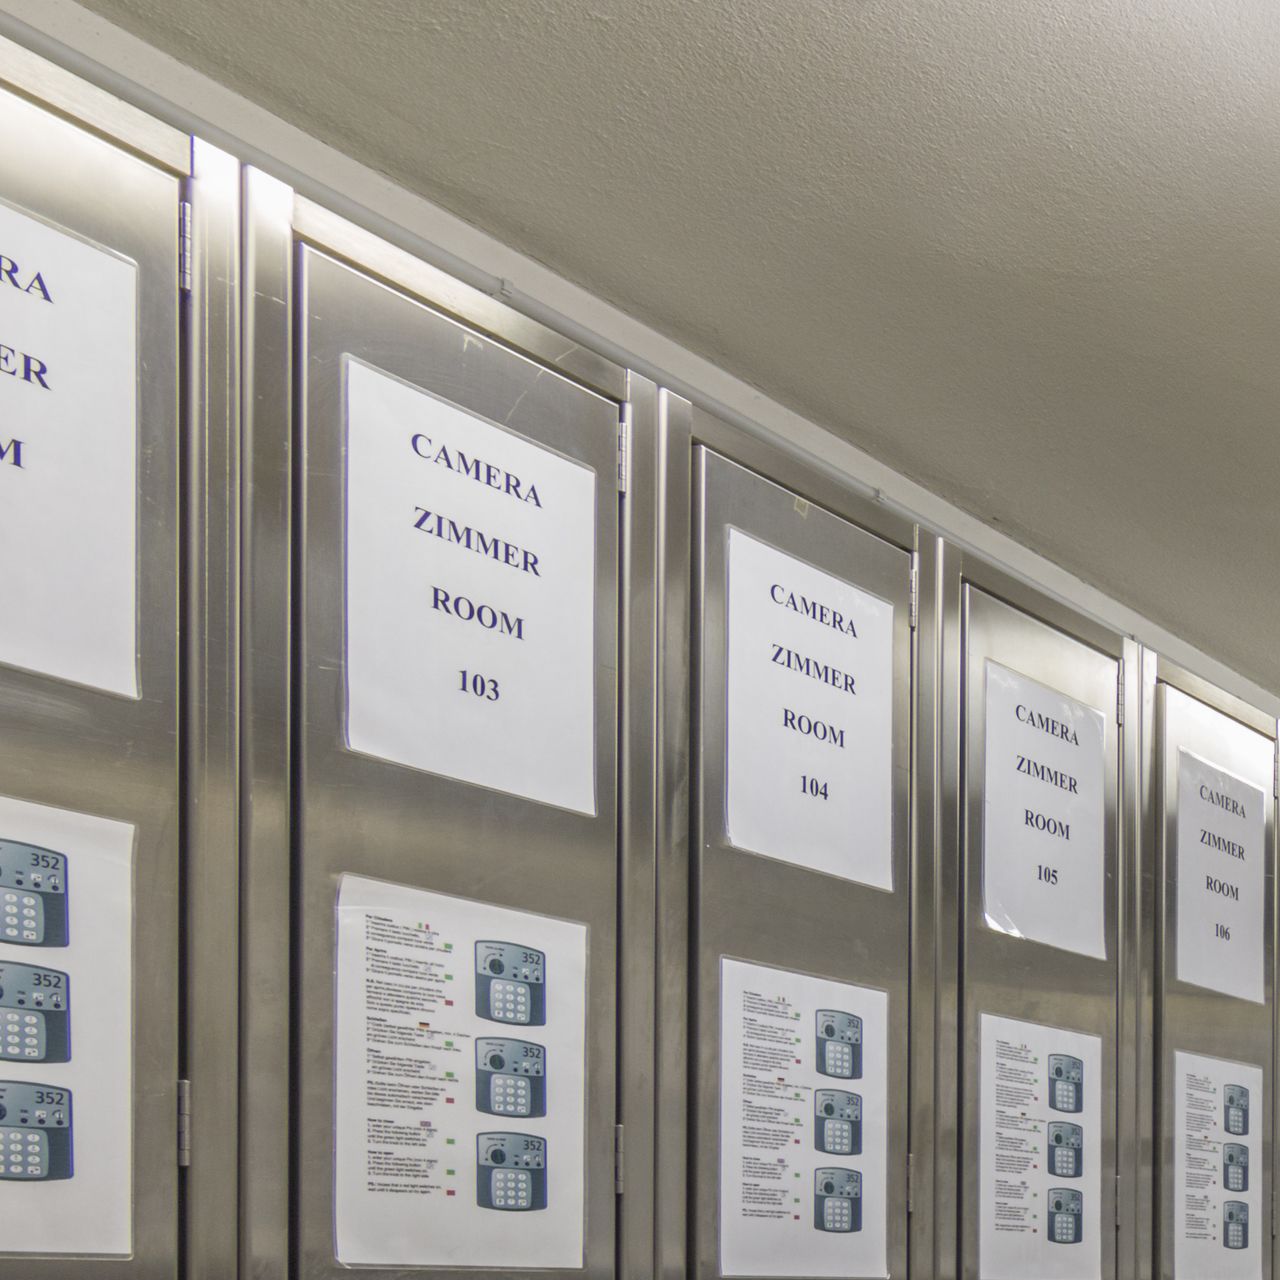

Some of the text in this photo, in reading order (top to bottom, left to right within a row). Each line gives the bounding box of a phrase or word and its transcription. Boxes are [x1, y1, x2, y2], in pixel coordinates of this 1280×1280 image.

[411, 433, 542, 509] CAMERA
[413, 506, 541, 577] ZIMMER
[432, 586, 524, 640] ROOM
[770, 584, 858, 639] CAMERA
[459, 670, 500, 702] 103
[771, 645, 856, 695] ZIMMER
[783, 708, 845, 748] ROOM
[1015, 704, 1080, 746] CAMERA
[801, 775, 829, 801] 104
[1016, 756, 1078, 795] ZIMMER
[1199, 784, 1247, 819] CAMERA
[1024, 809, 1070, 841] ROOM
[1199, 828, 1245, 861] ZIMMER
[31, 854, 60, 870] 352
[1037, 864, 1058, 886] 105
[1206, 875, 1239, 901] ROOM
[1215, 923, 1231, 941] 106
[522, 952, 541, 965] 352
[33, 973, 62, 989] 352
[522, 1047, 542, 1060] 352
[35, 1091, 65, 1106] 352
[523, 1139, 542, 1151] 352
